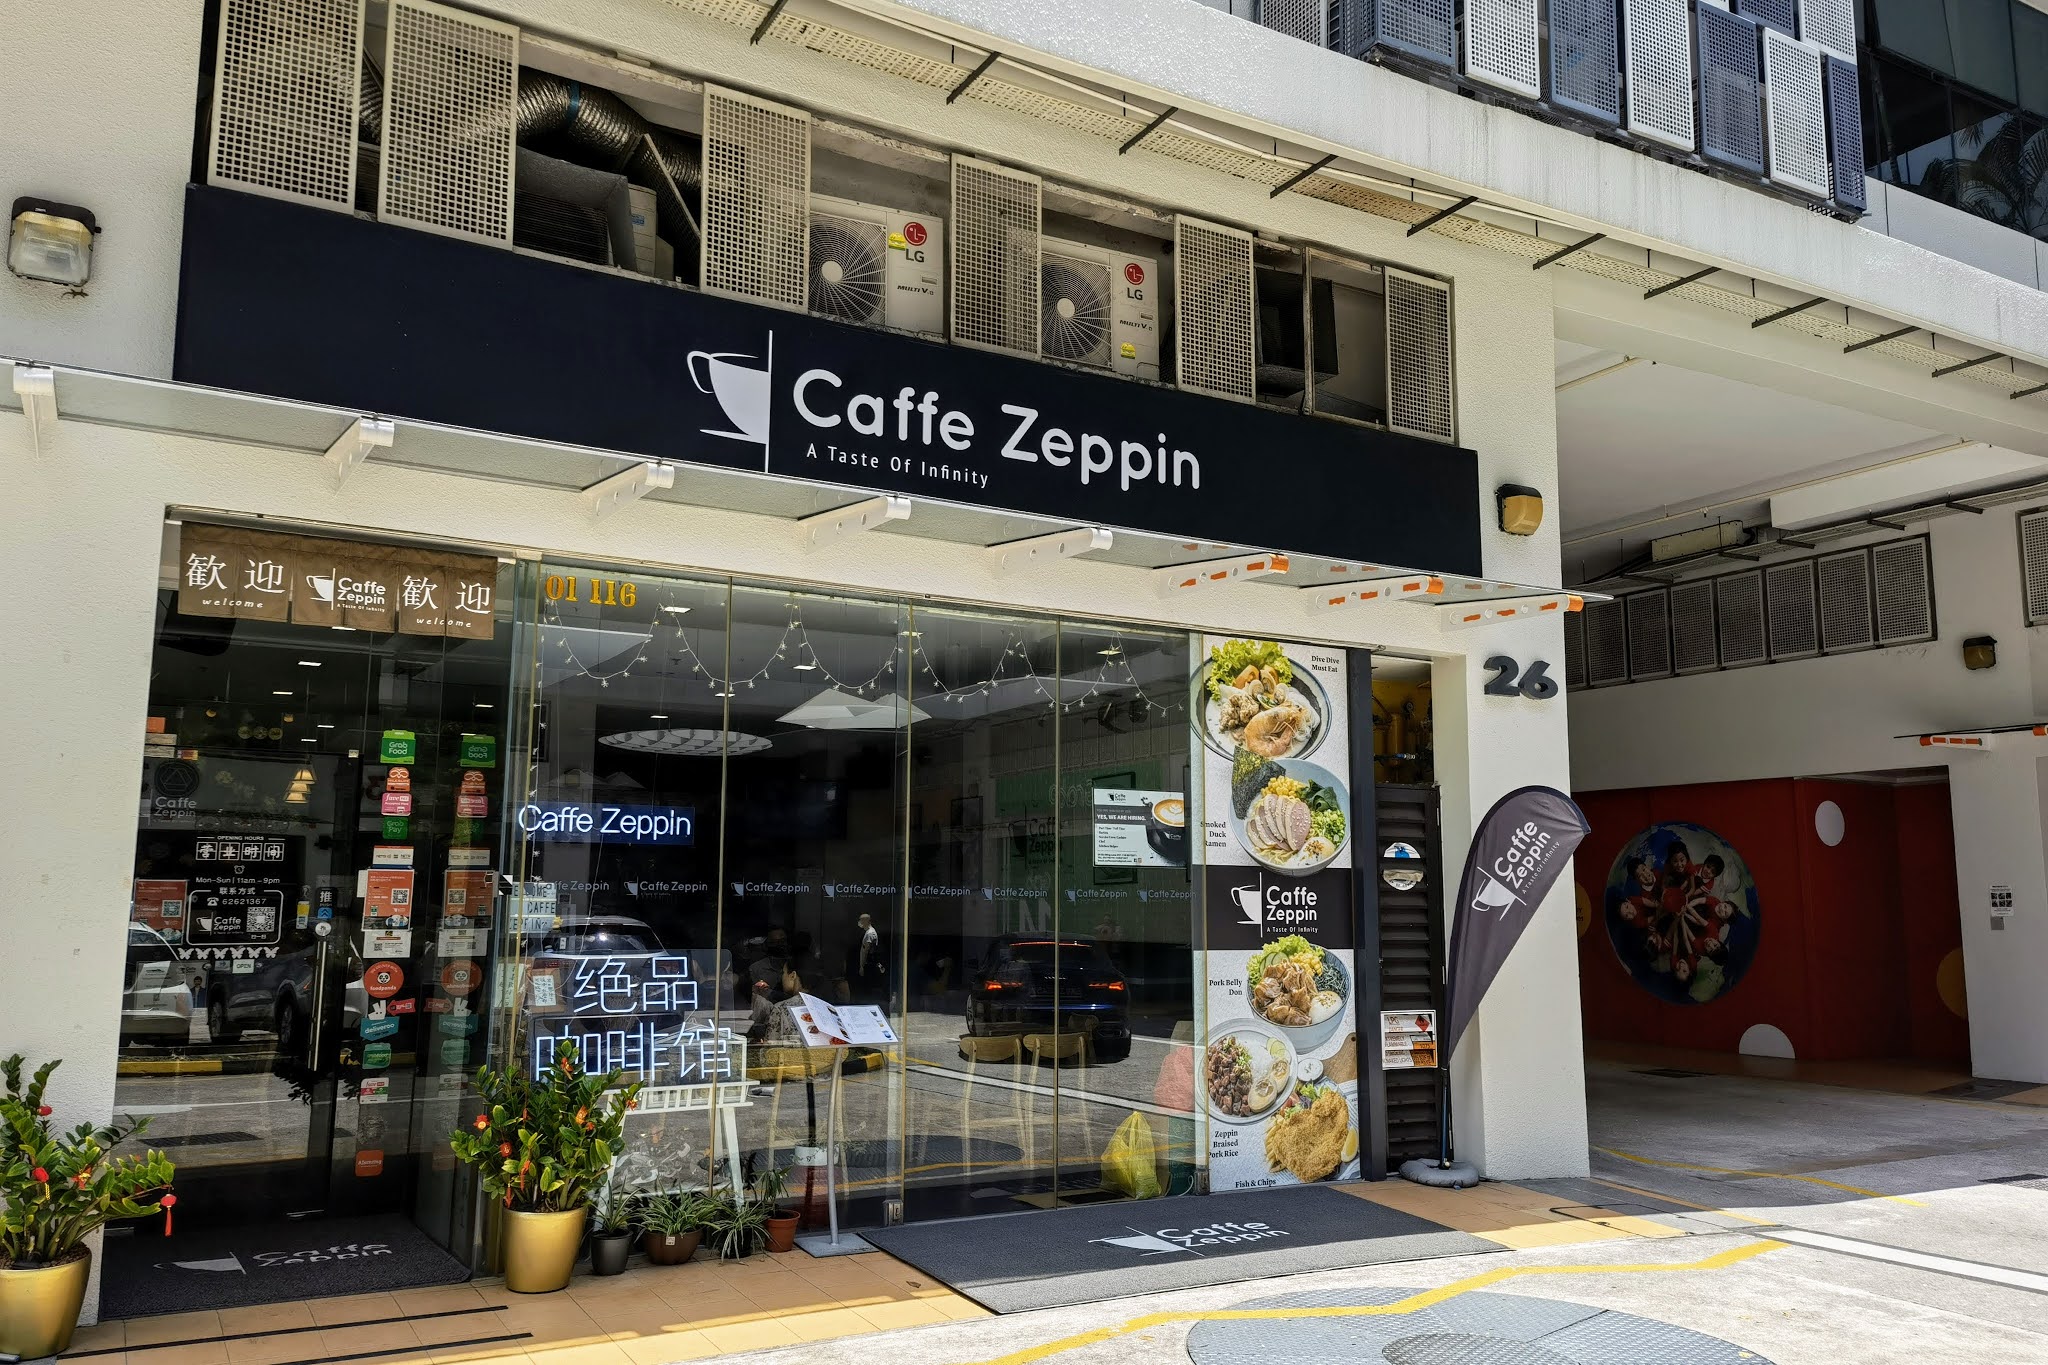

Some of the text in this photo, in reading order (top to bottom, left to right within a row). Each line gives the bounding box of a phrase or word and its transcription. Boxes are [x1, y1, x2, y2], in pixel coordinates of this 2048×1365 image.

[905, 249, 925, 262] LG
[1127, 287, 1143, 300] LG
[793, 368, 1200, 491] Caffe Zeppin
[806, 443, 988, 489] A Taste Of Infinity
[338, 577, 386, 595] Caffe
[545, 575, 637, 607] 01 116
[202, 598, 264, 608] welcome
[338, 590, 385, 606] Zeppin
[416, 618, 472, 628] welcome
[1311, 664, 1326, 672] Must
[1483, 655, 1558, 700] 26
[156, 796, 196, 808] Caffe
[154, 808, 196, 818] Zeppin
[518, 804, 691, 840] Caffe Zeppin
[388, 826, 403, 834] Pay
[1494, 822, 1538, 876] Caffe
[1506, 832, 1551, 889] Zeppin
[220, 887, 256, 895] 联系方式
[570, 881, 609, 893] Zeppin
[640, 881, 708, 893] Caffe Zeppin
[745, 882, 810, 894] Caffe Zeppin
[836, 884, 896, 896] Caffe Zeppin
[913, 886, 970, 897] Caffe Zeppin
[320, 891, 332, 902] 推
[994, 888, 1048, 899] Caffe Zeppin
[1076, 889, 1128, 900] Caffe Zeppin
[1148, 890, 1170, 898] Caffe
[1266, 885, 1317, 906] Caffe
[528, 902, 555, 913] CAFFE
[214, 916, 241, 924] Caffe
[1266, 905, 1317, 924] Zeppin
[574, 956, 698, 1012] 绝品
[1226, 979, 1242, 988] Belly
[364, 1023, 395, 1034] deliveroo
[536, 1019, 732, 1082] 咖啡馆
[1215, 1129, 1238, 1139] Zeppin
[1213, 1139, 1238, 1148] Braised
[1209, 1149, 1239, 1158] Pork Rice
[1257, 1178, 1276, 1187] Chips
[1156, 1222, 1270, 1239] Caffe
[1172, 1229, 1290, 1247] Zeppin
[252, 1244, 388, 1261] Caffe
[258, 1250, 393, 1266] Zeppin
